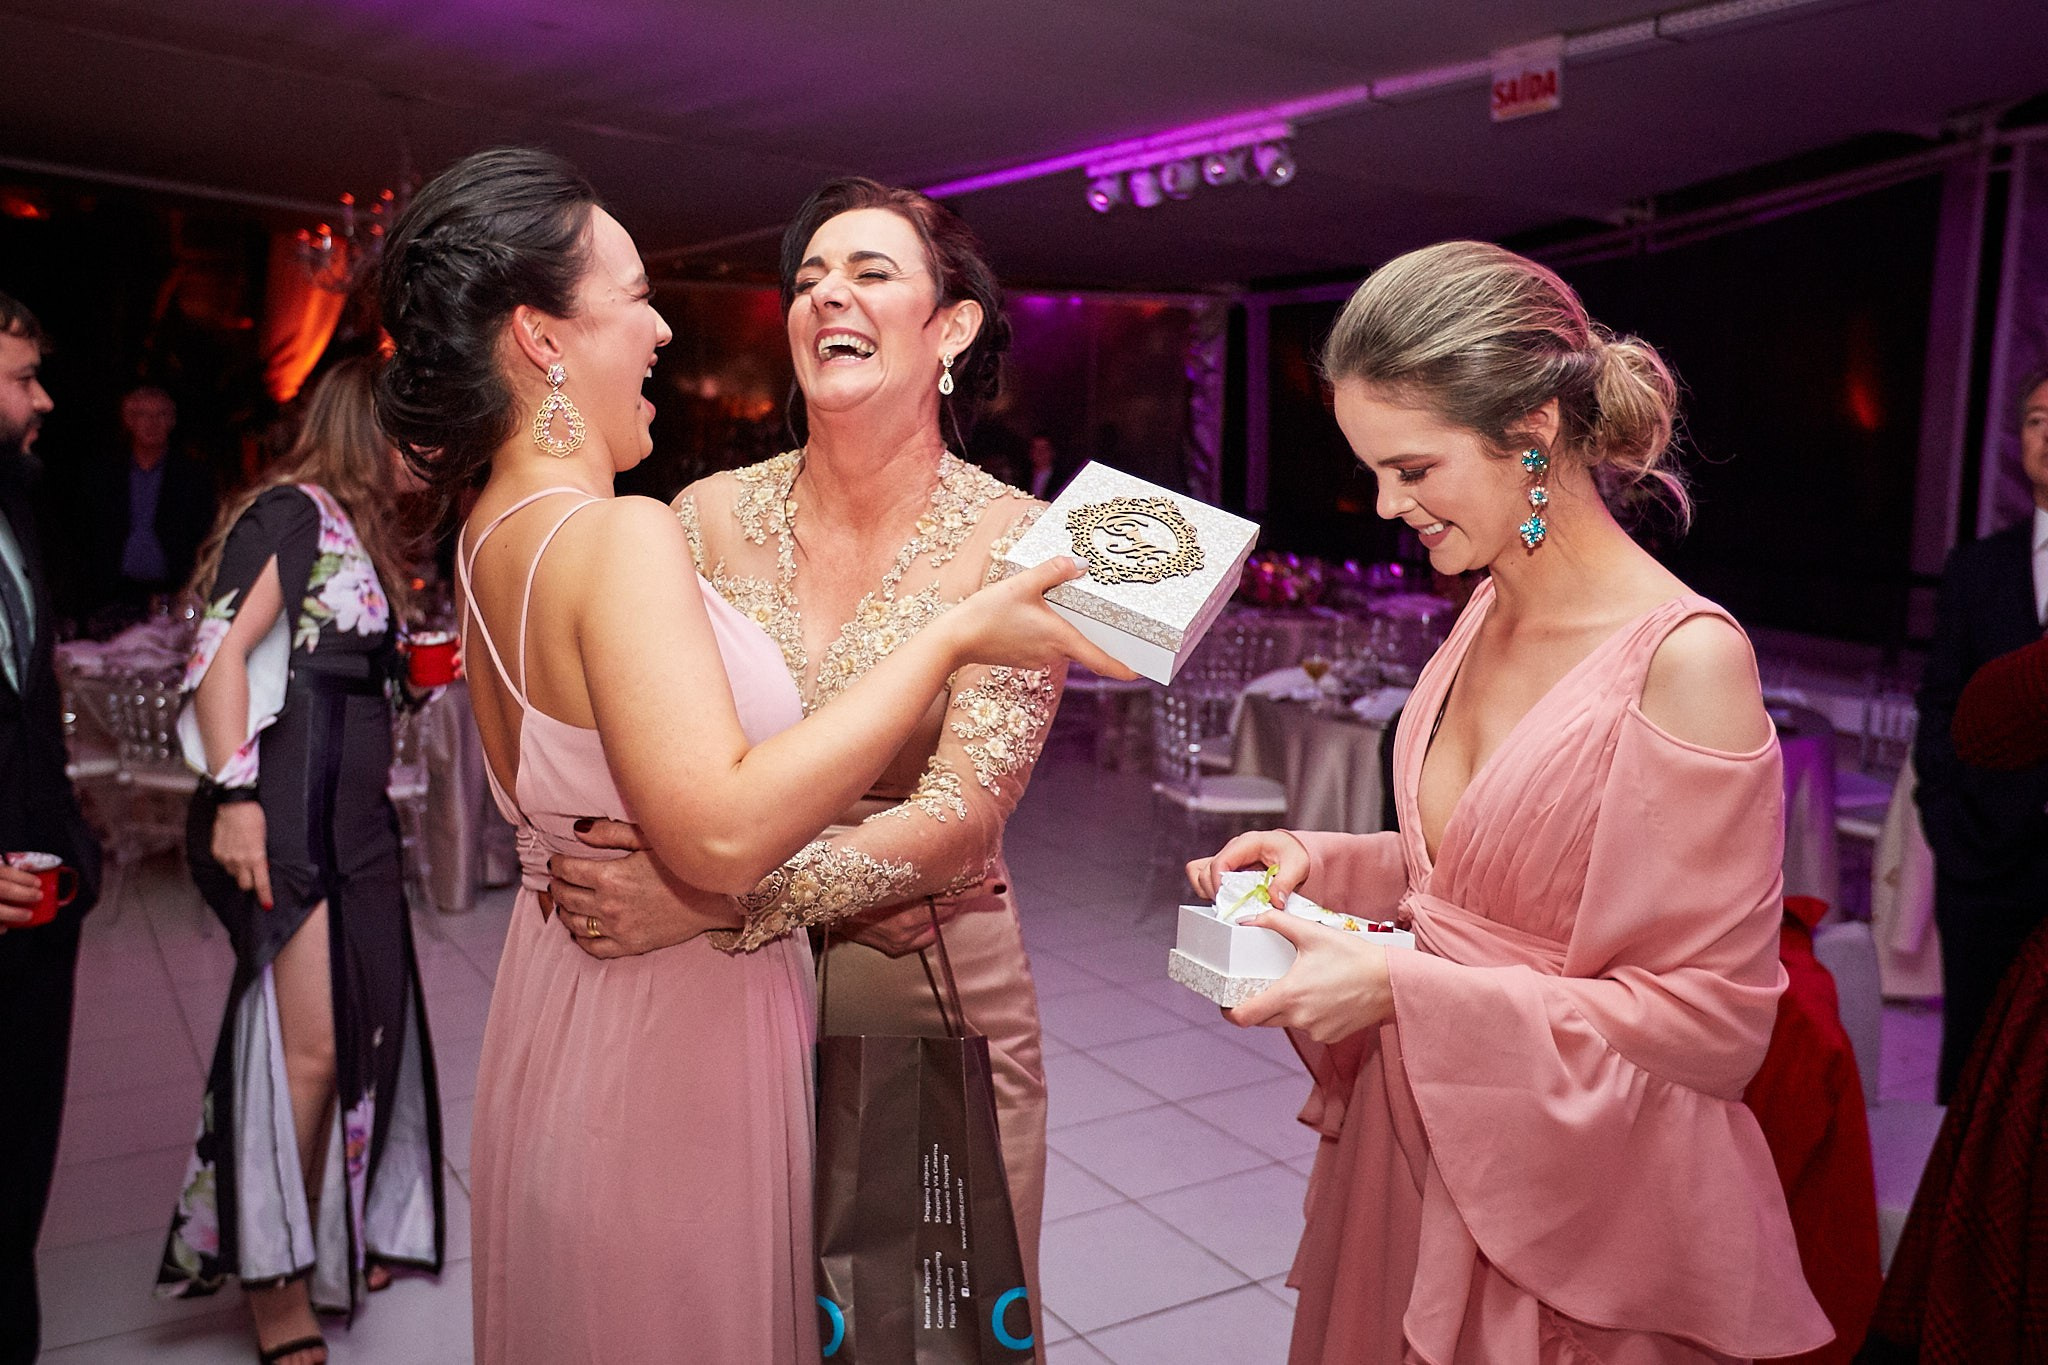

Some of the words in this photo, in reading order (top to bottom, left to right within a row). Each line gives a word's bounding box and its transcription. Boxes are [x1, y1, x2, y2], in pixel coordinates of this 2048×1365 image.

[923, 1258, 931, 1295] Shopping
[947, 1267, 955, 1302] Shopping
[923, 1295, 931, 1329] Beiramar
[936, 1287, 944, 1329] Continente
[949, 1302, 957, 1329] Floripa
